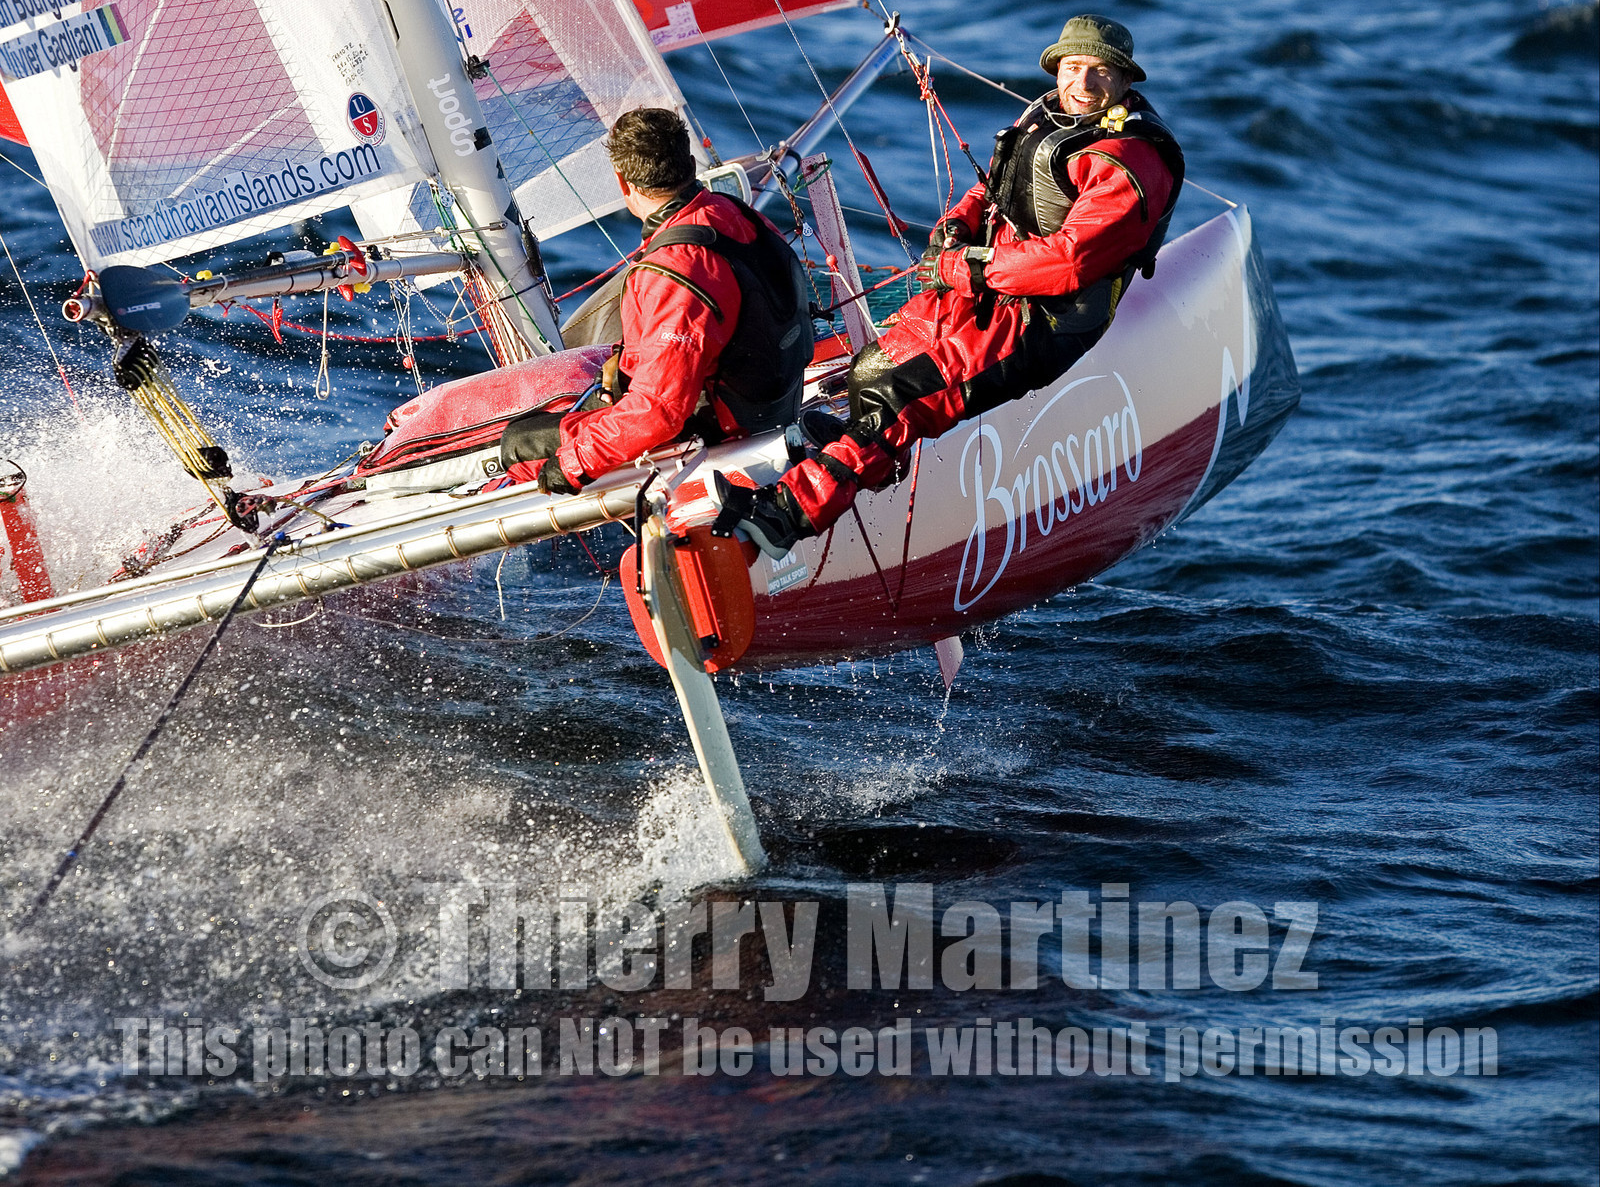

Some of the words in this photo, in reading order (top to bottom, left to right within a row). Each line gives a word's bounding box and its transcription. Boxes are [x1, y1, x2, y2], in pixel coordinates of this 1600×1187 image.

[0, 37, 46, 80] livier
[38, 12, 103, 72] Gagliani
[91, 143, 381, 256] www.scandinavianislands.com
[953, 370, 1143, 612] Brossard
